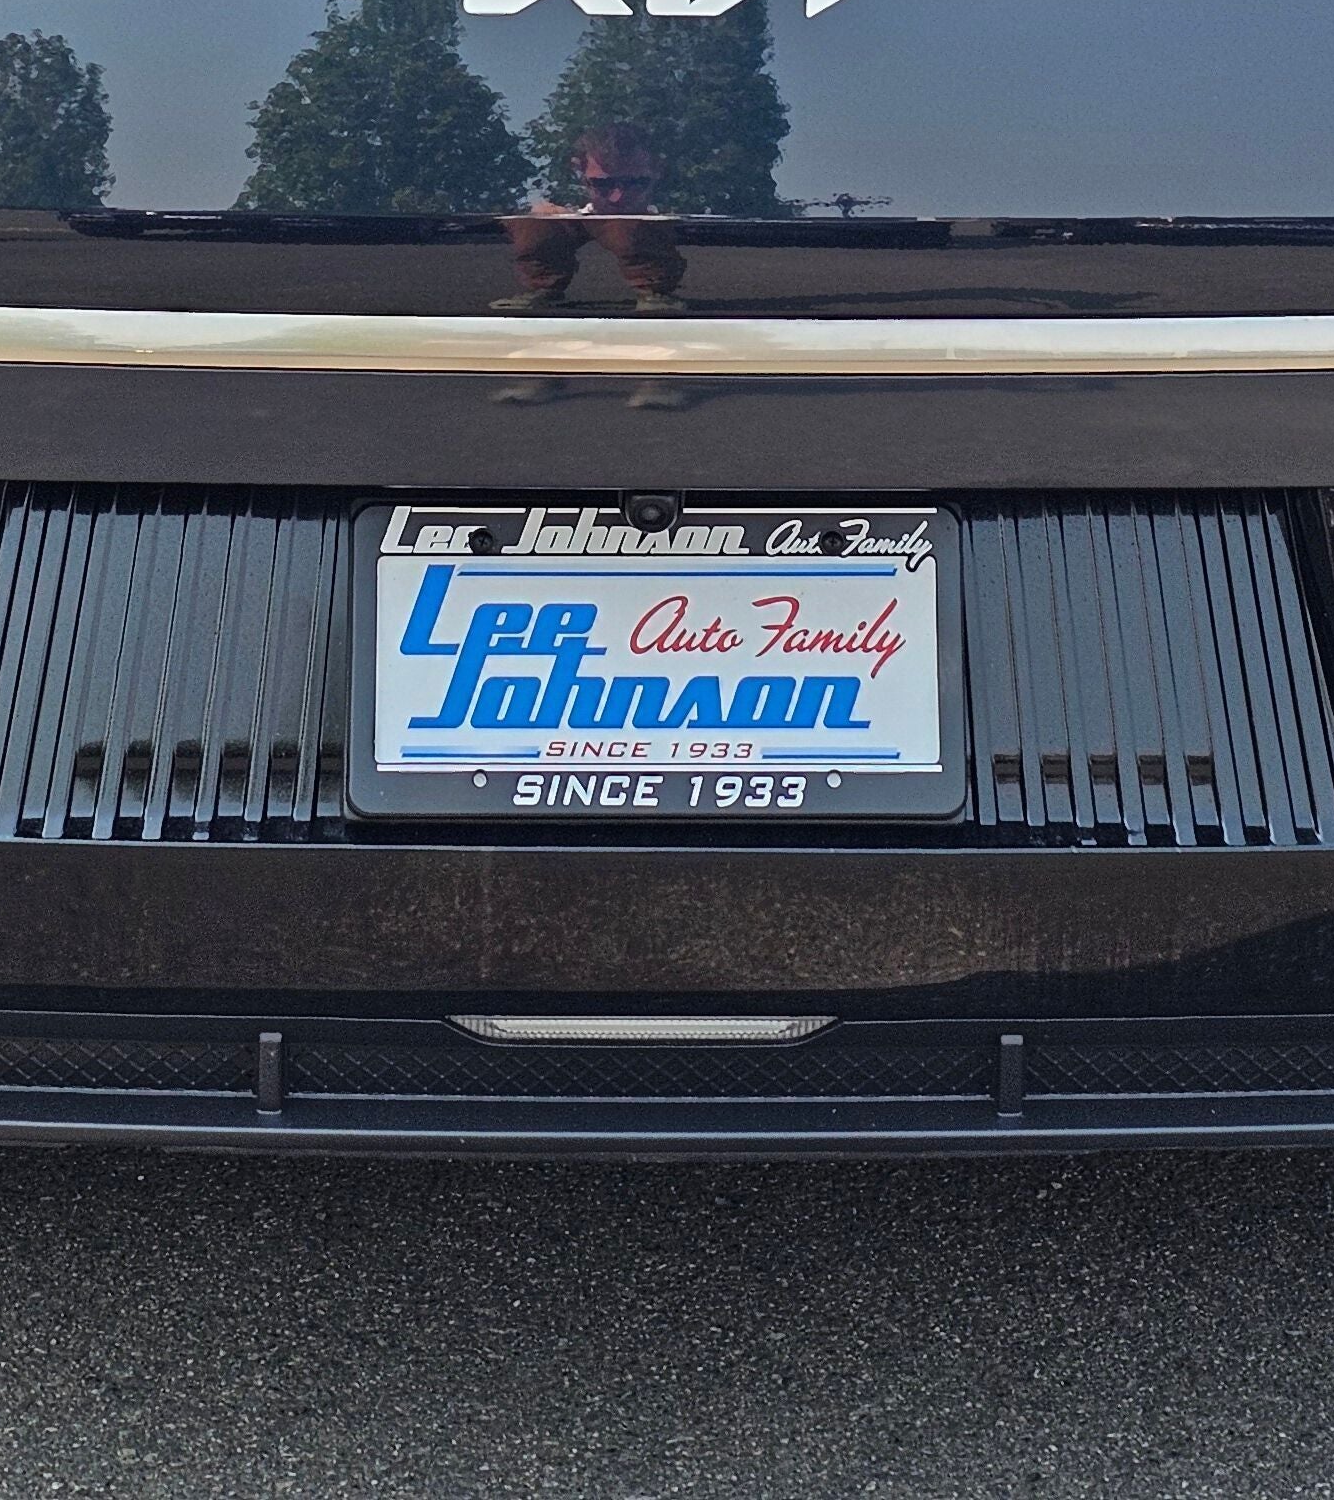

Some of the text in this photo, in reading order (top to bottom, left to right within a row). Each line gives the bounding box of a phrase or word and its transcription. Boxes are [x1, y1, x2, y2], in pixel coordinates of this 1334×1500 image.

[500, 507, 750, 555] Johnson
[838, 517, 933, 569] Family
[399, 564, 907, 679] Lee Auto Family
[407, 650, 872, 730] Johnson
[545, 741, 754, 760] SINCE 1933
[512, 774, 807, 808] SINCE 1933
